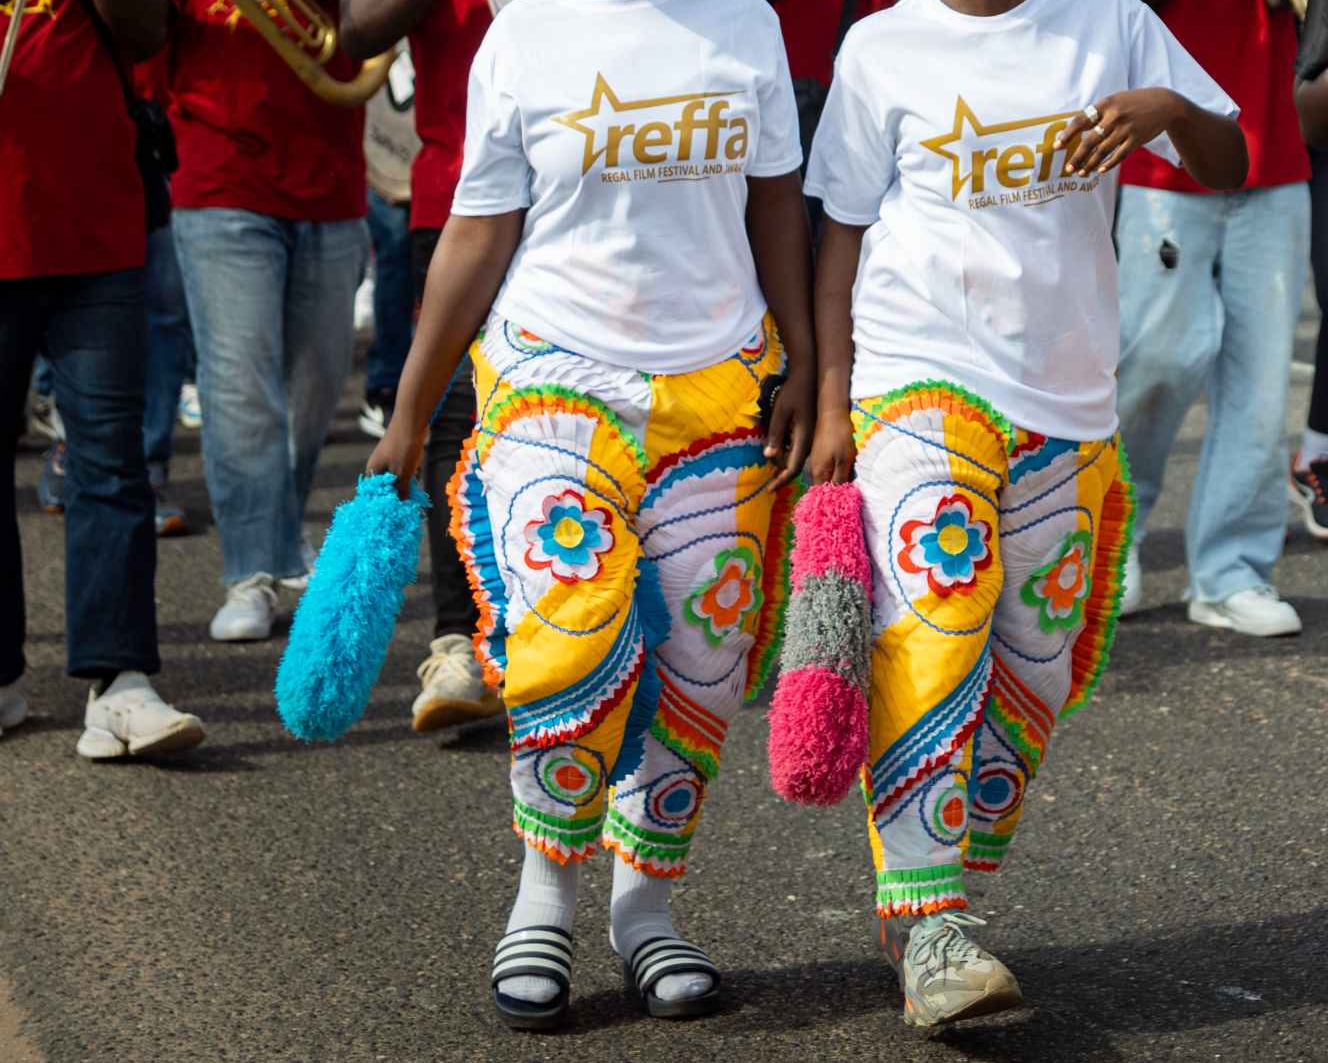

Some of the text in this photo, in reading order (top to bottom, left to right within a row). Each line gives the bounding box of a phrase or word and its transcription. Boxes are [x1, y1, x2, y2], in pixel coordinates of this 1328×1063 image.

[607, 101, 748, 167] reffa
[601, 170, 631, 183] REGAL
[634, 167, 656, 181] FILM
[658, 165, 699, 178] FESTIVAL
[702, 164, 722, 175] AND
[968, 196, 999, 211] REGAL
[1000, 191, 1021, 205] FILM
[1058, 181, 1077, 193] AND
